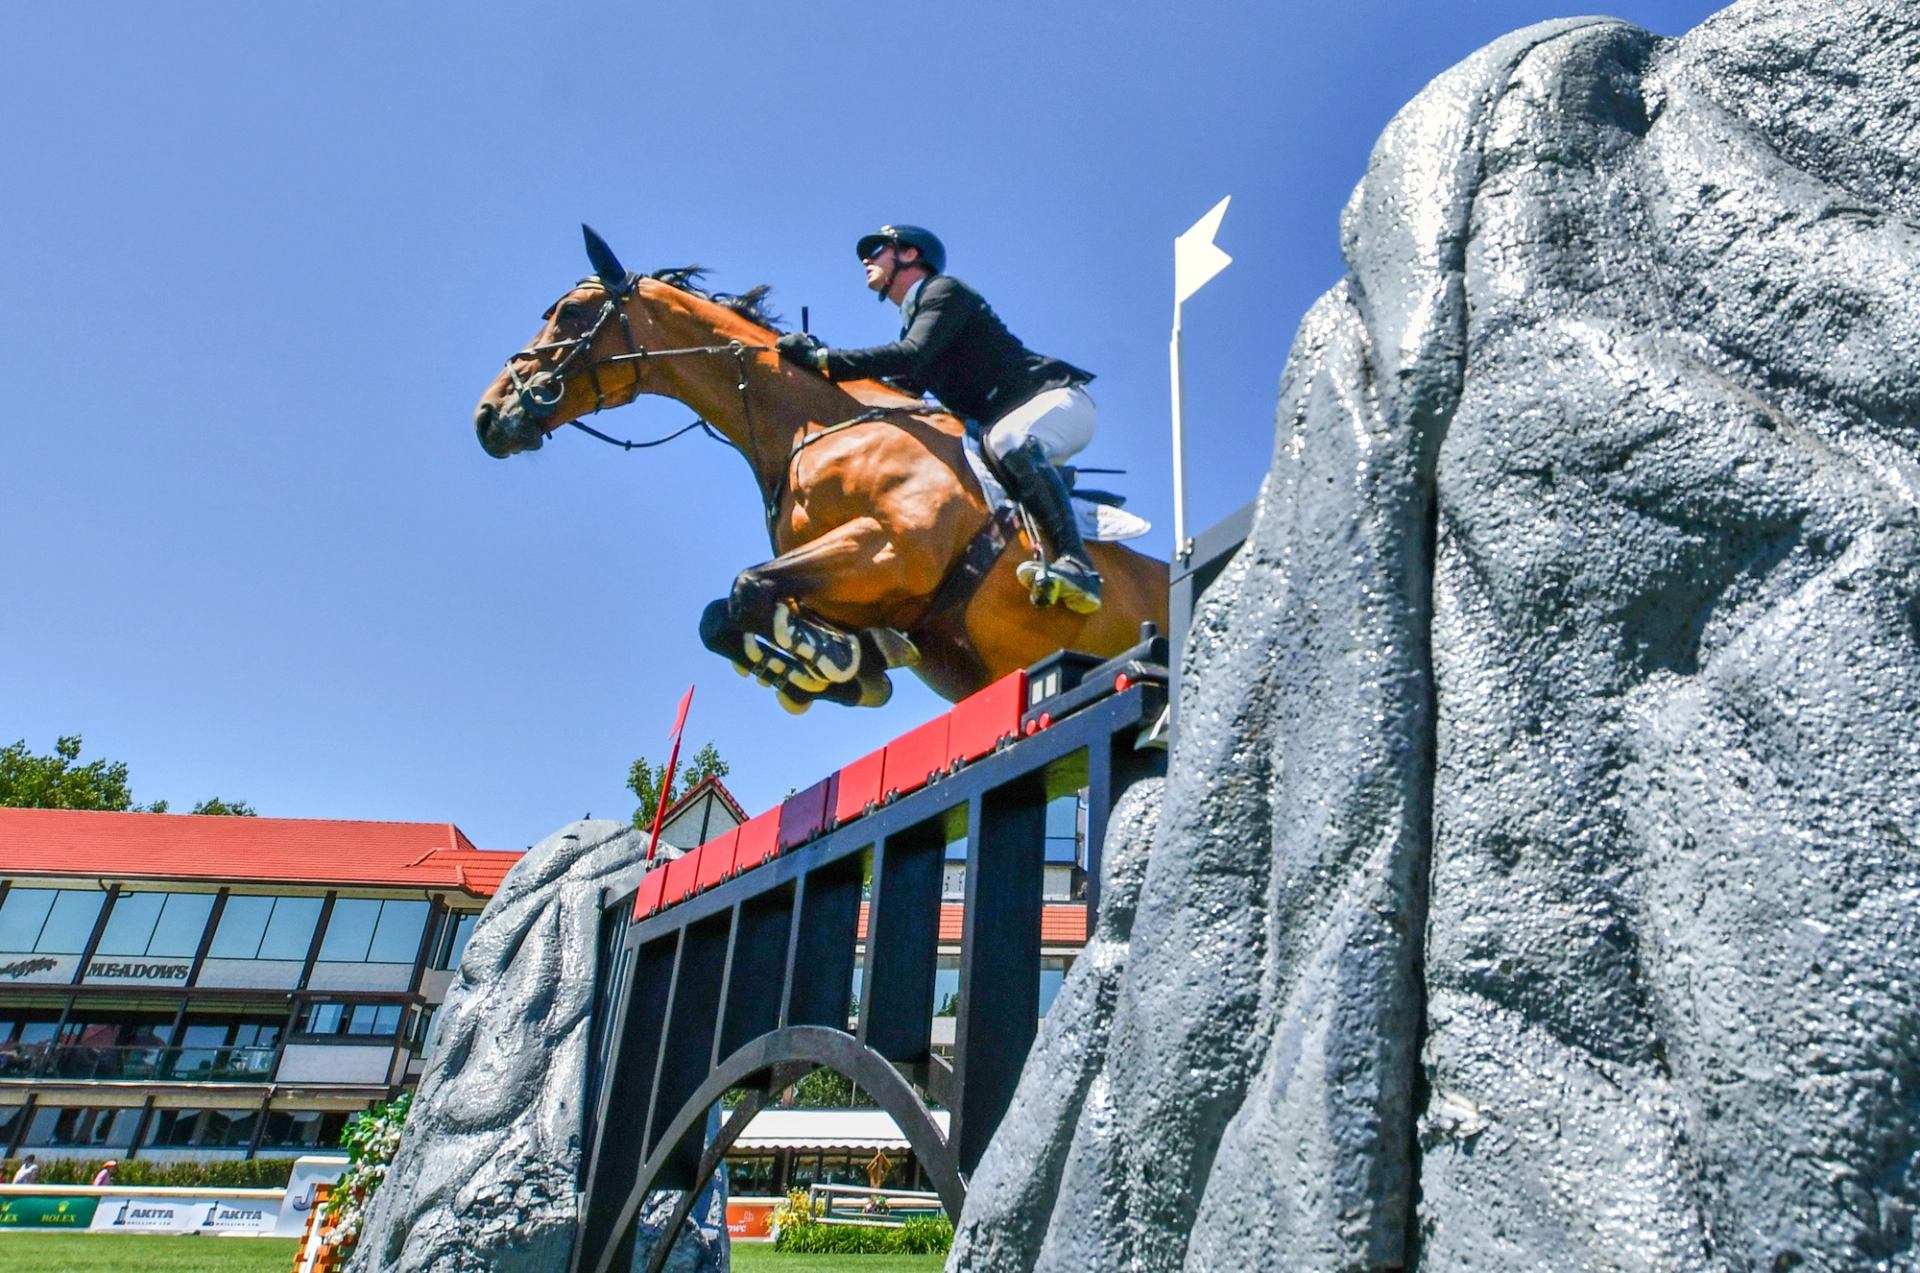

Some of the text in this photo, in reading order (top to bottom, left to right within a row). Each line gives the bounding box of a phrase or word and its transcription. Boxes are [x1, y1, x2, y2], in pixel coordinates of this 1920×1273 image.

[86, 962, 190, 980] MEADOWS
[41, 1214, 77, 1222] ROLEX
[130, 1209, 174, 1218] AKITA
[219, 1210, 262, 1219] AKITA
